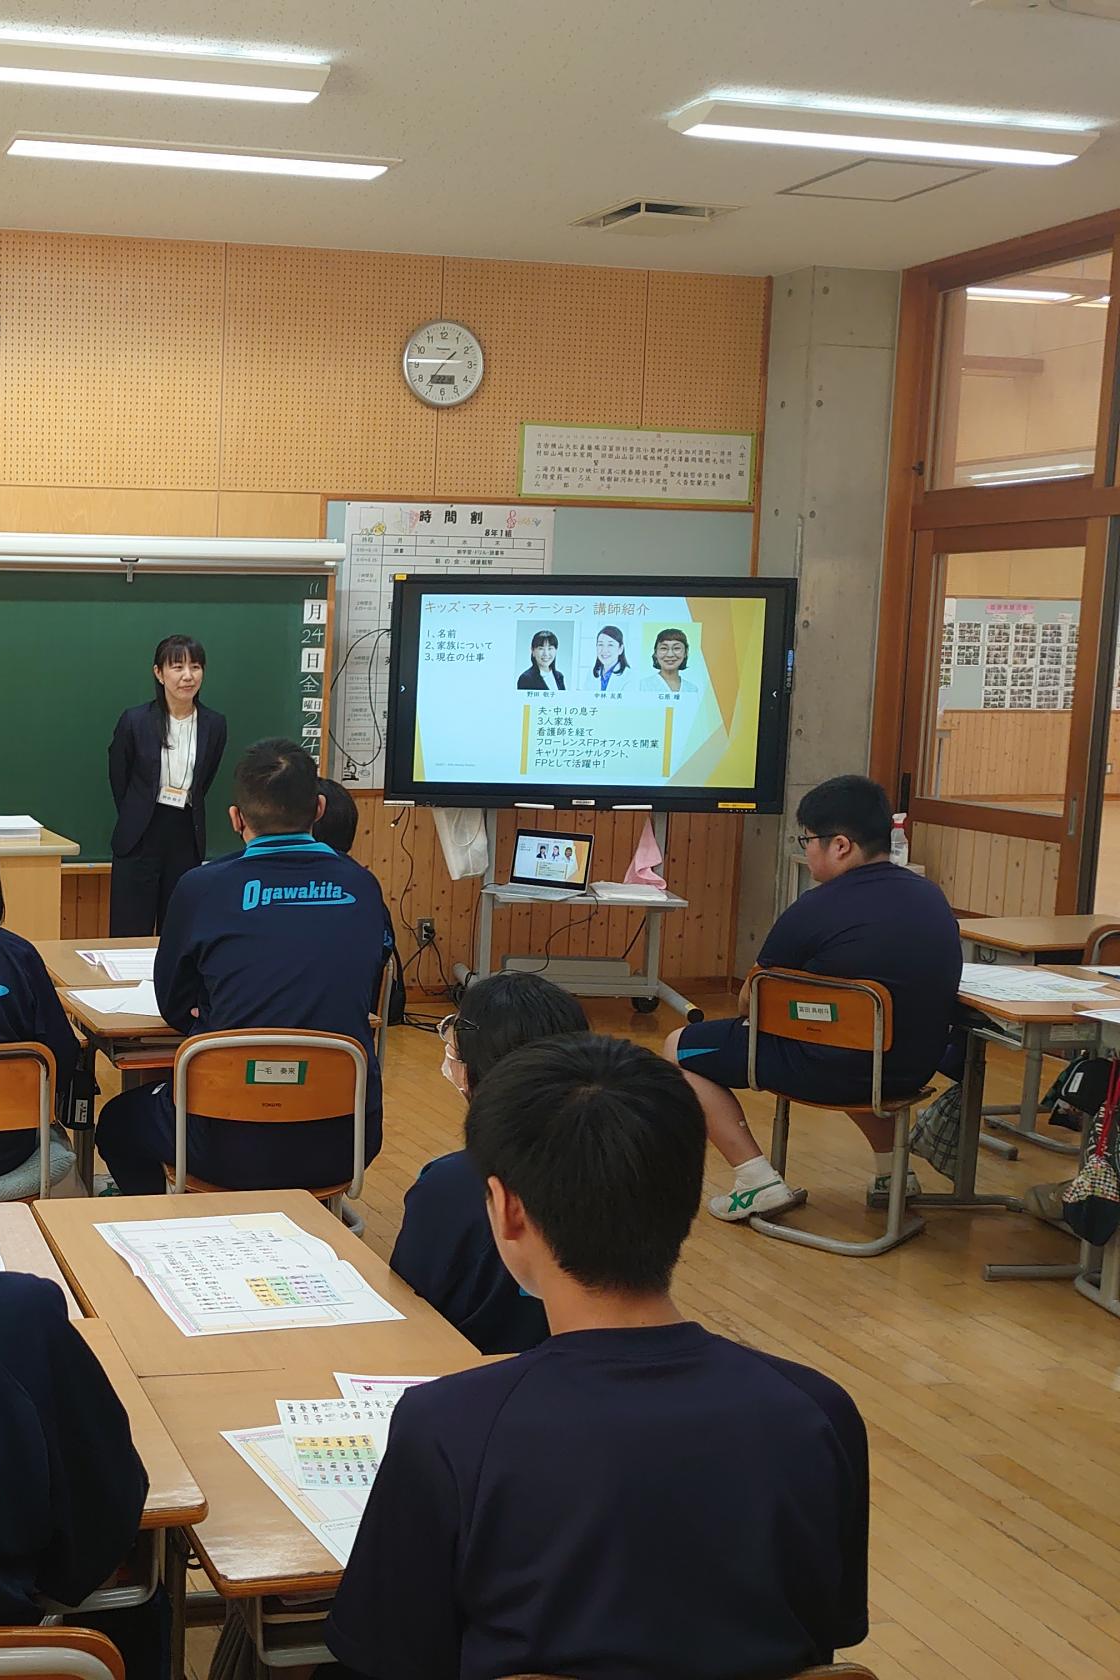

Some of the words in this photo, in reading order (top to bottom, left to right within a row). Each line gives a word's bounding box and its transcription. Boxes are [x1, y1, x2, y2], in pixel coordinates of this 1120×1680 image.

[427, 335, 434, 344] 11
[440, 331, 448, 340] 12
[417, 346, 426, 354] 10
[464, 346, 469, 354] 2
[467, 361, 473, 369] 3
[462, 375, 468, 383] 4
[440, 388, 446, 396] 6
[453, 385, 459, 393] 5
[419, 509, 483, 525] 時間割
[484, 529, 512, 538] 8年1組
[308, 604, 322, 620] 月
[425, 601, 585, 615] キッズ・マネー・ステーション
[593, 602, 651, 616] 講師紹介
[301, 629, 324, 644] 24
[307, 653, 319, 668] 日
[299, 674, 320, 693] 金
[304, 700, 321, 710] 曜日
[303, 712, 318, 727] 2
[537, 717, 574, 726] 3人家族
[536, 727, 594, 737] 看護師を経て
[300, 737, 319, 753] 4
[536, 738, 659, 749] フローレンスFPオフィスを開業
[243, 880, 343, 911] Ogawakita
